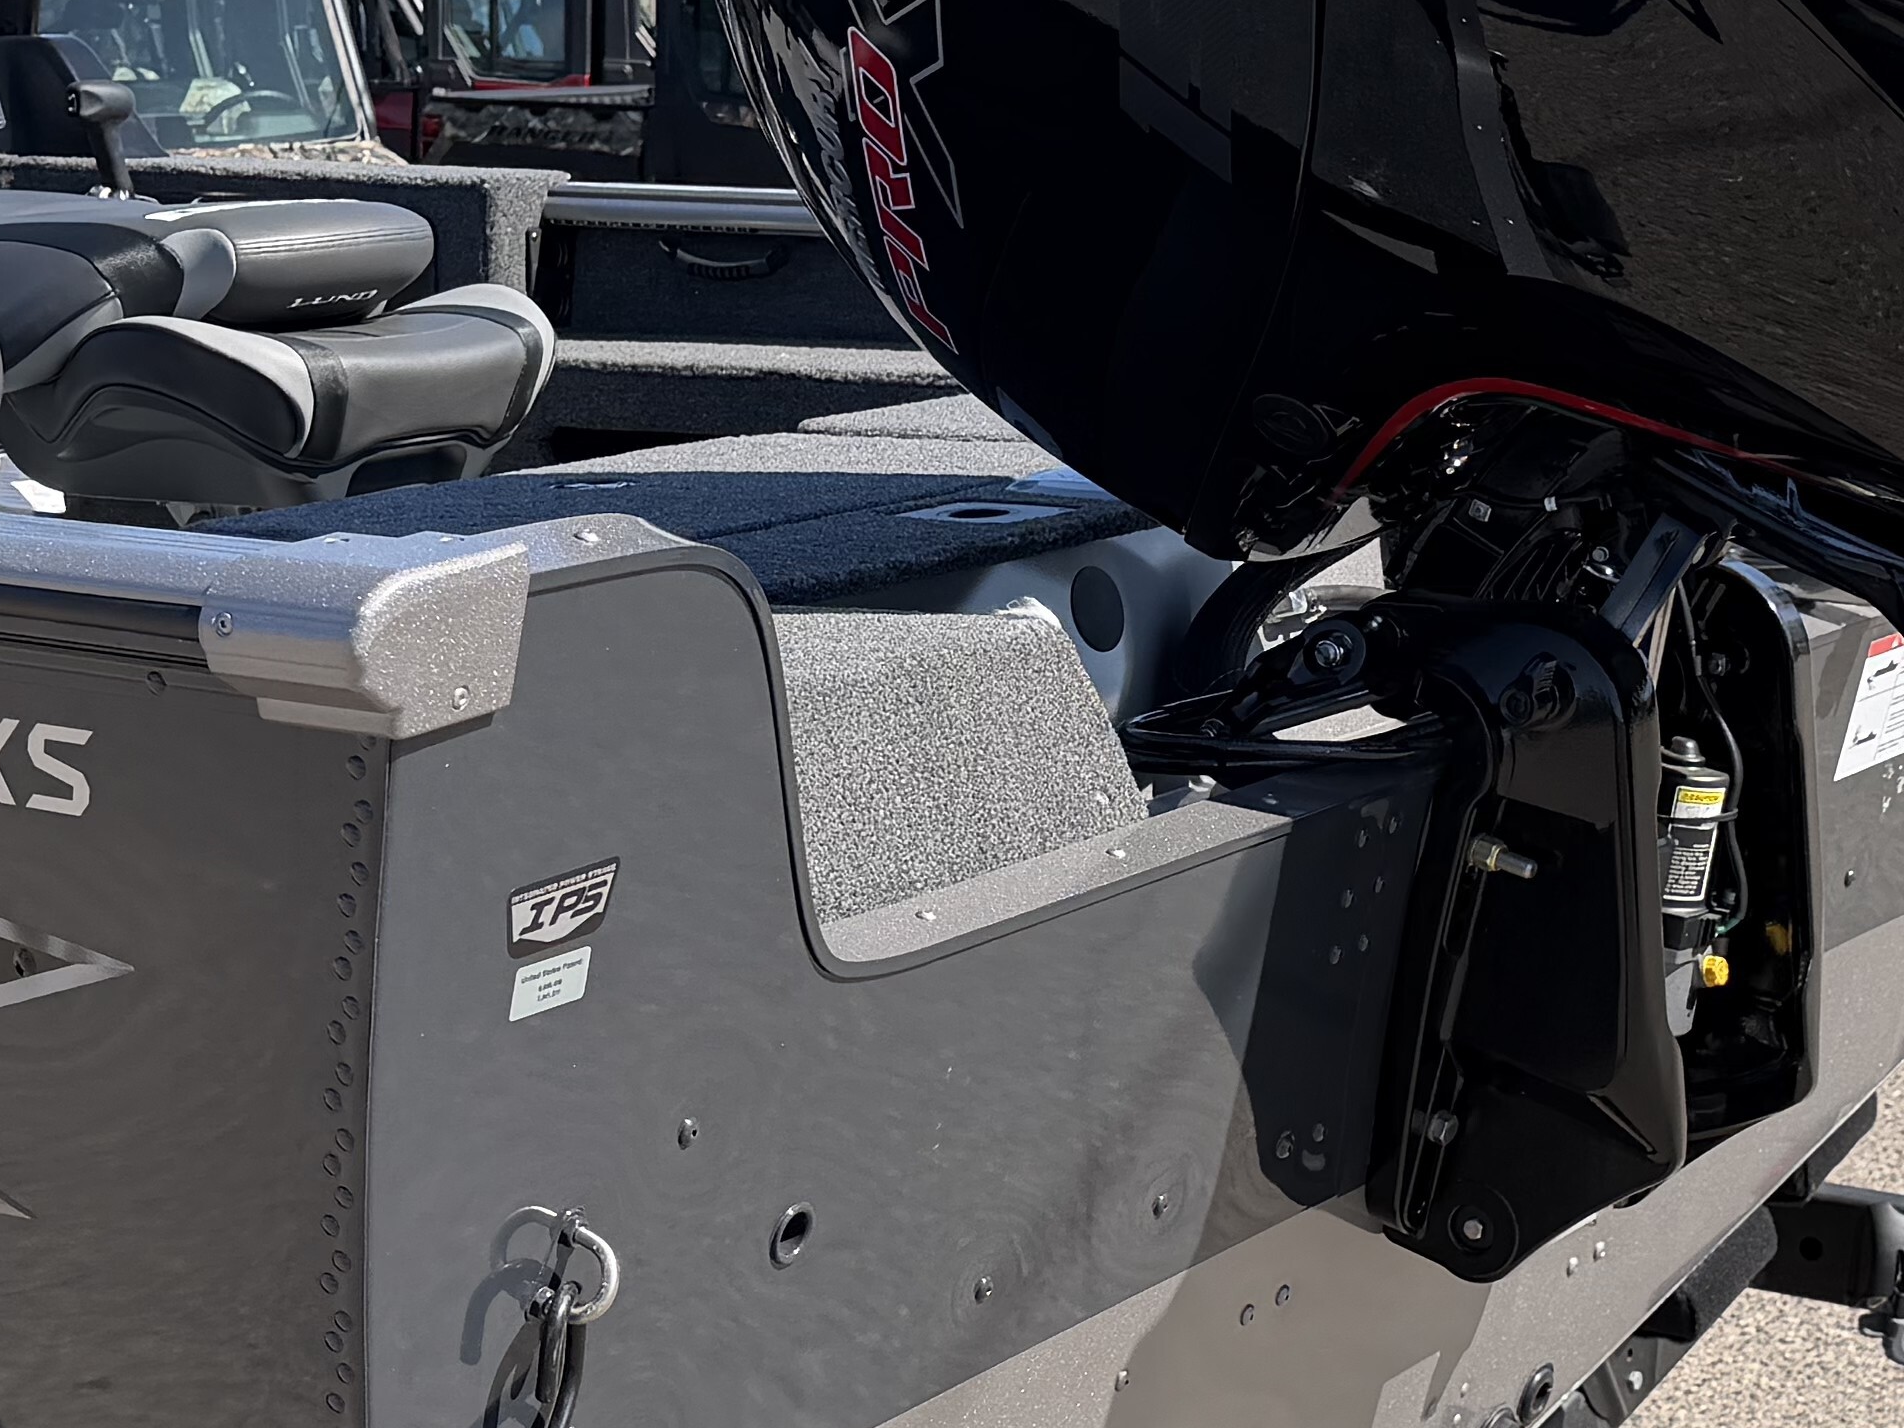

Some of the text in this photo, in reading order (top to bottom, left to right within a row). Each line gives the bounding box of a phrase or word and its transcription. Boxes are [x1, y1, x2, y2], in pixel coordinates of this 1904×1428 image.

[847, 26, 959, 355] PRO
[285, 288, 378, 309] LUND
[519, 880, 608, 936] IPS
